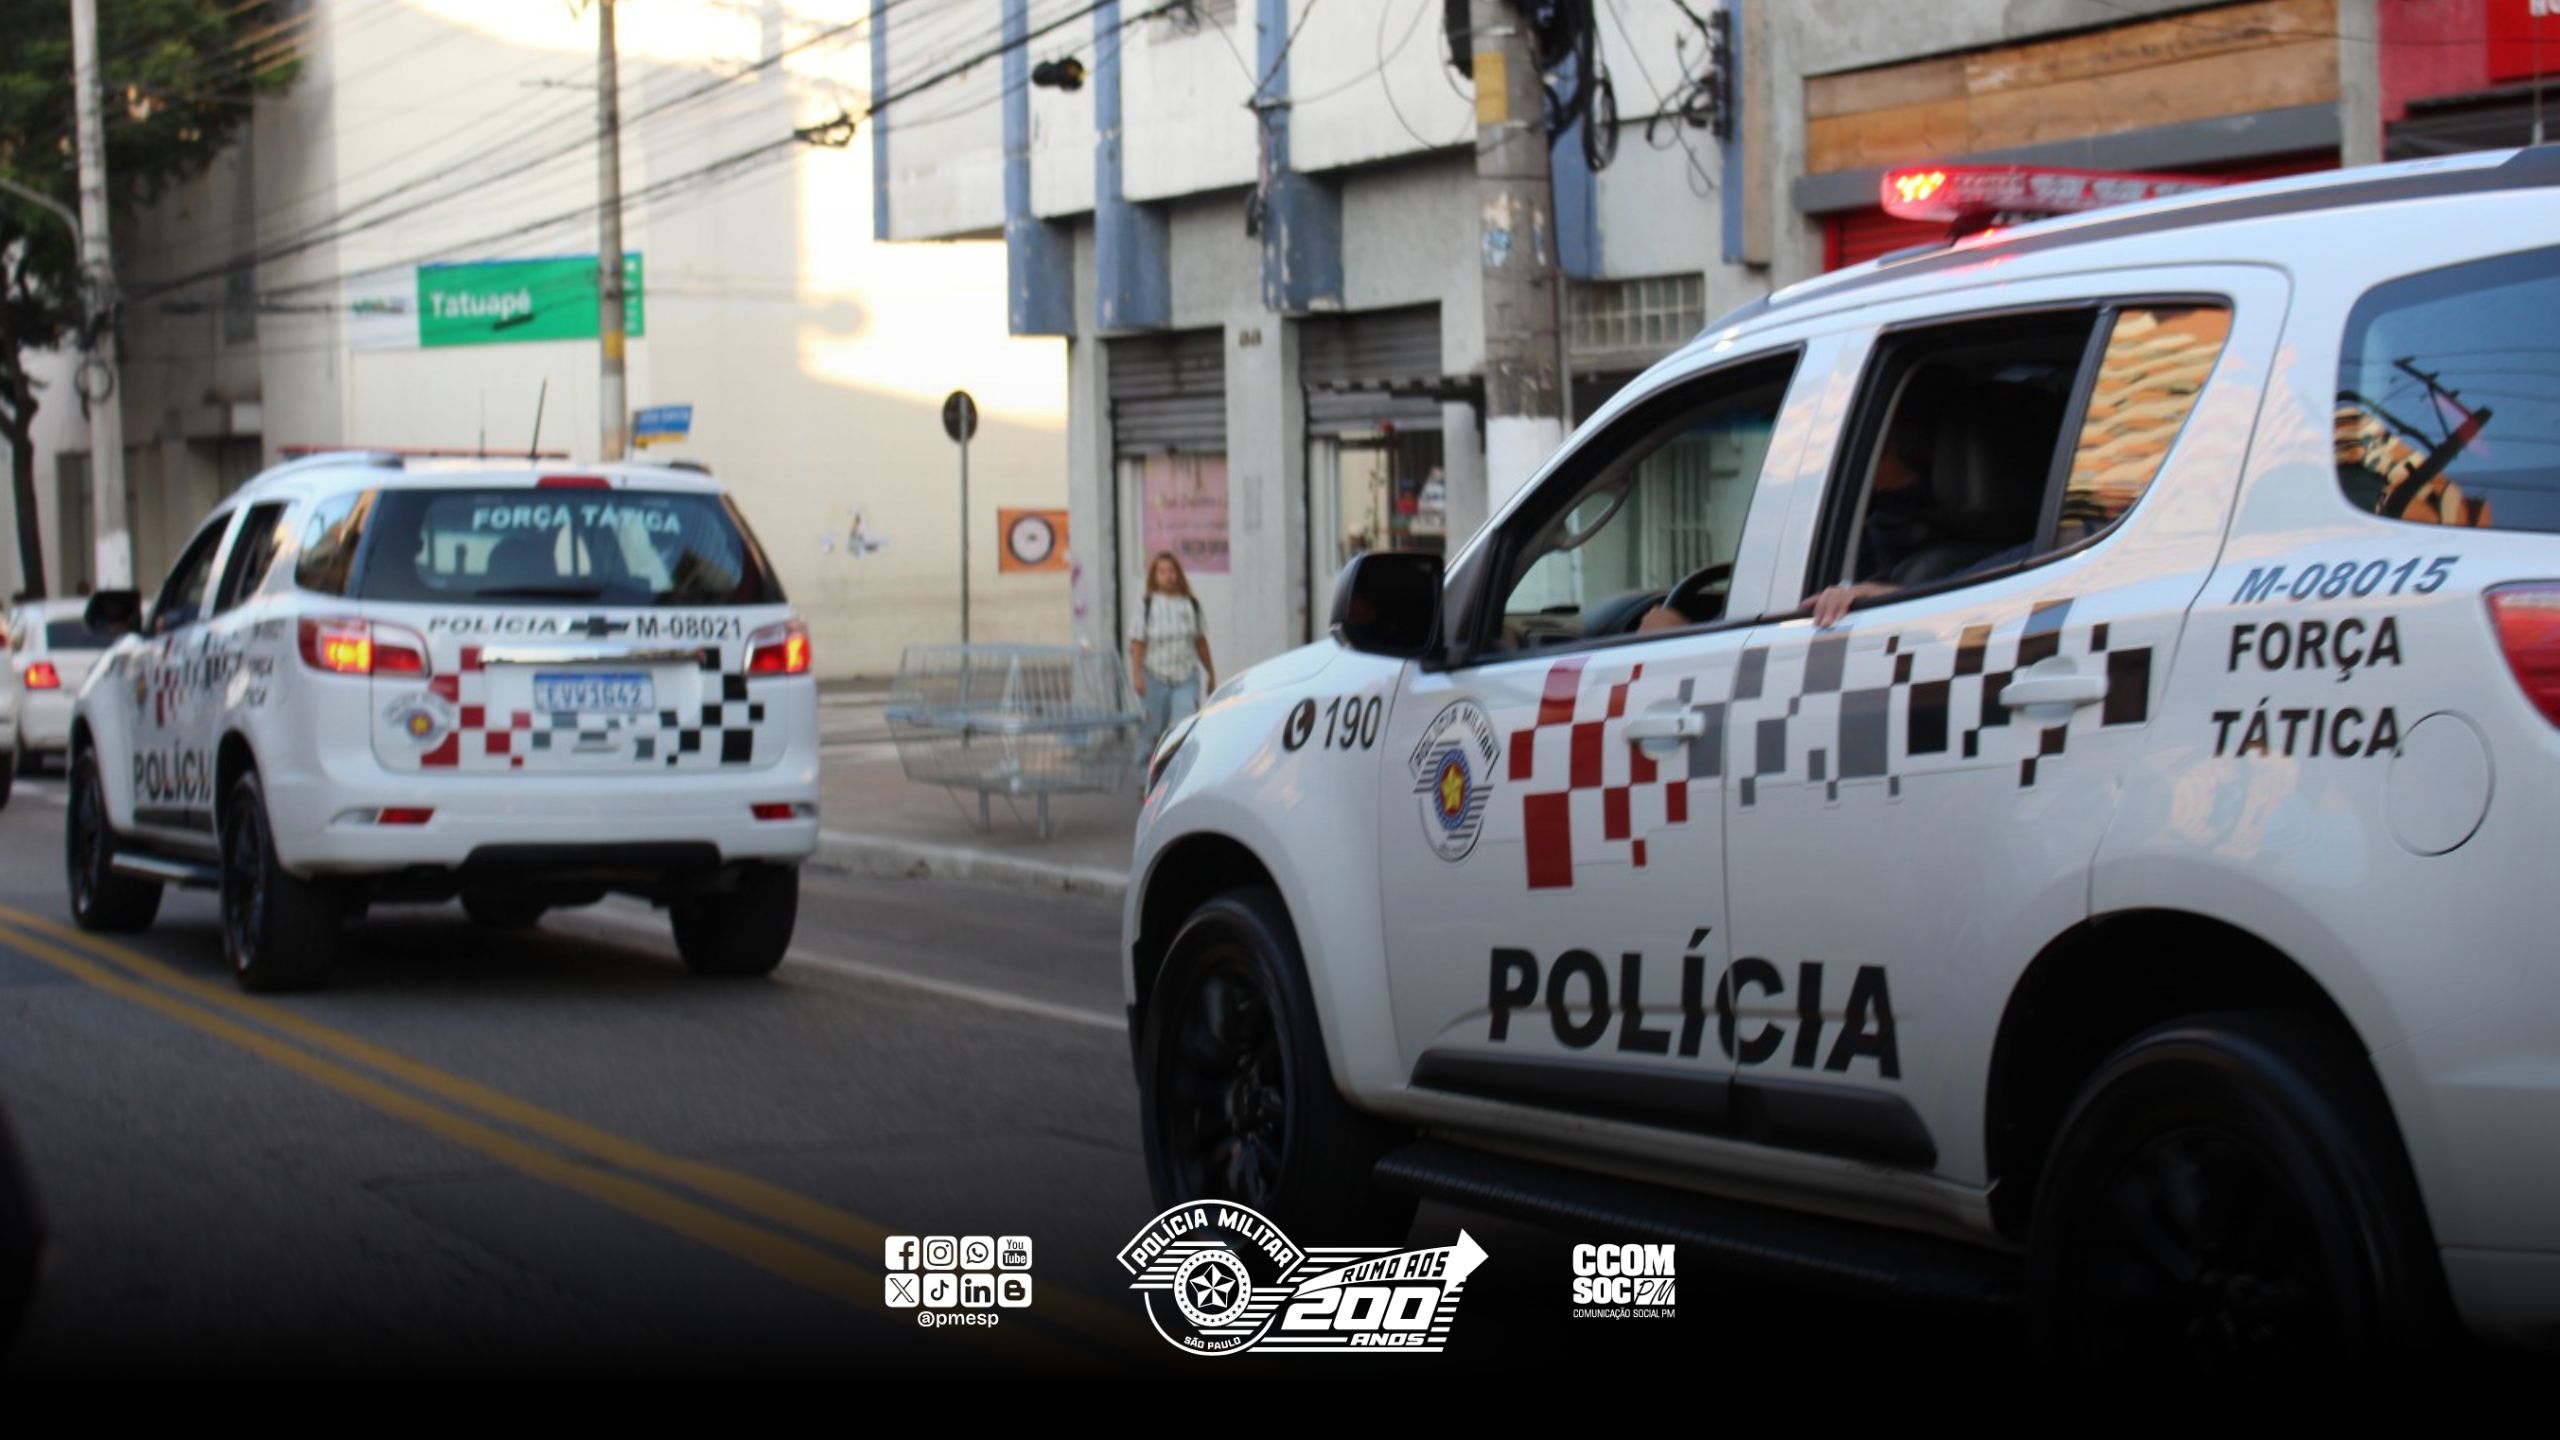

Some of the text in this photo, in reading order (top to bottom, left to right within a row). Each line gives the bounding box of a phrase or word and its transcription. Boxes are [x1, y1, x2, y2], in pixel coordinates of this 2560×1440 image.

[429, 287, 532, 320] Tatuapé
[472, 503, 680, 535] FORÇA TÁTICA
[2229, 555, 2460, 604] M-08015
[428, 614, 742, 640] POLÍCIA M-08021
[2228, 616, 2402, 682] FORÇA
[1324, 695, 1383, 750] 190
[2211, 697, 2406, 759] TÁTICA
[1487, 927, 1902, 1080] POLÍCIA
